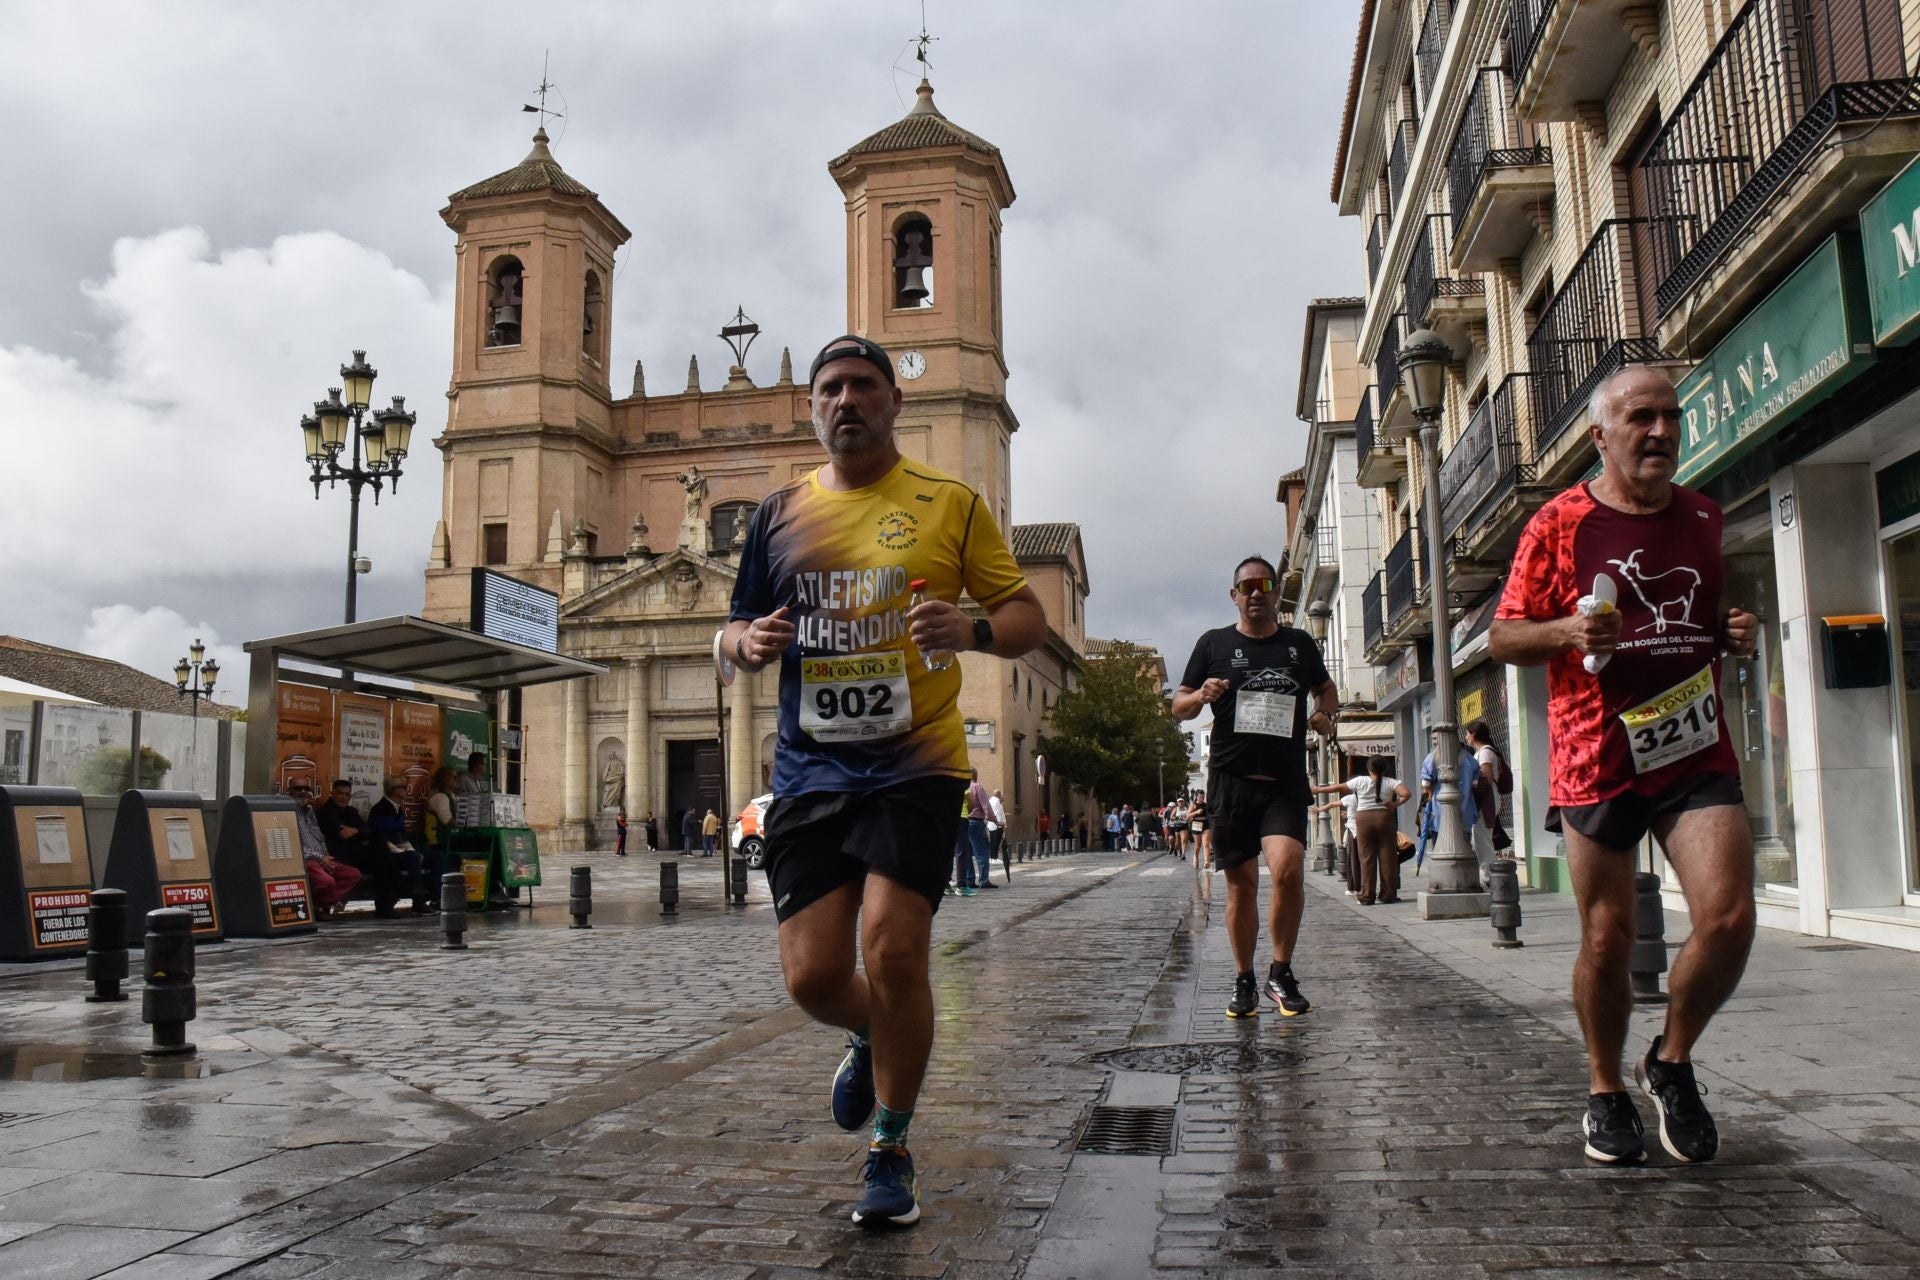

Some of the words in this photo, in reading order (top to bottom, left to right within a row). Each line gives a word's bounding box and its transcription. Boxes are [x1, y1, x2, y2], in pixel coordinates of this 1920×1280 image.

[1786, 346, 1847, 403] PROMOTORA
[1685, 341, 1779, 449] RBANA
[878, 511, 918, 527] ATLETISMO
[796, 565, 908, 610] ATLETISMO
[1635, 637, 1668, 647] BOSQUE
[1669, 636, 1683, 644] DEL
[1651, 646, 1678, 656] LUGROS
[814, 662, 829, 677] 38
[829, 663, 885, 678] FONDO
[815, 684, 894, 720] 902
[1638, 706, 1656, 719] 38
[1634, 693, 1717, 754] 3210
[34, 894, 87, 907] PROHIBIDO
[43, 917, 64, 930] FUERA
[64, 917, 73, 928] DE
[73, 916, 86, 927] LOS
[40, 928, 89, 944] CONTENEDORES
